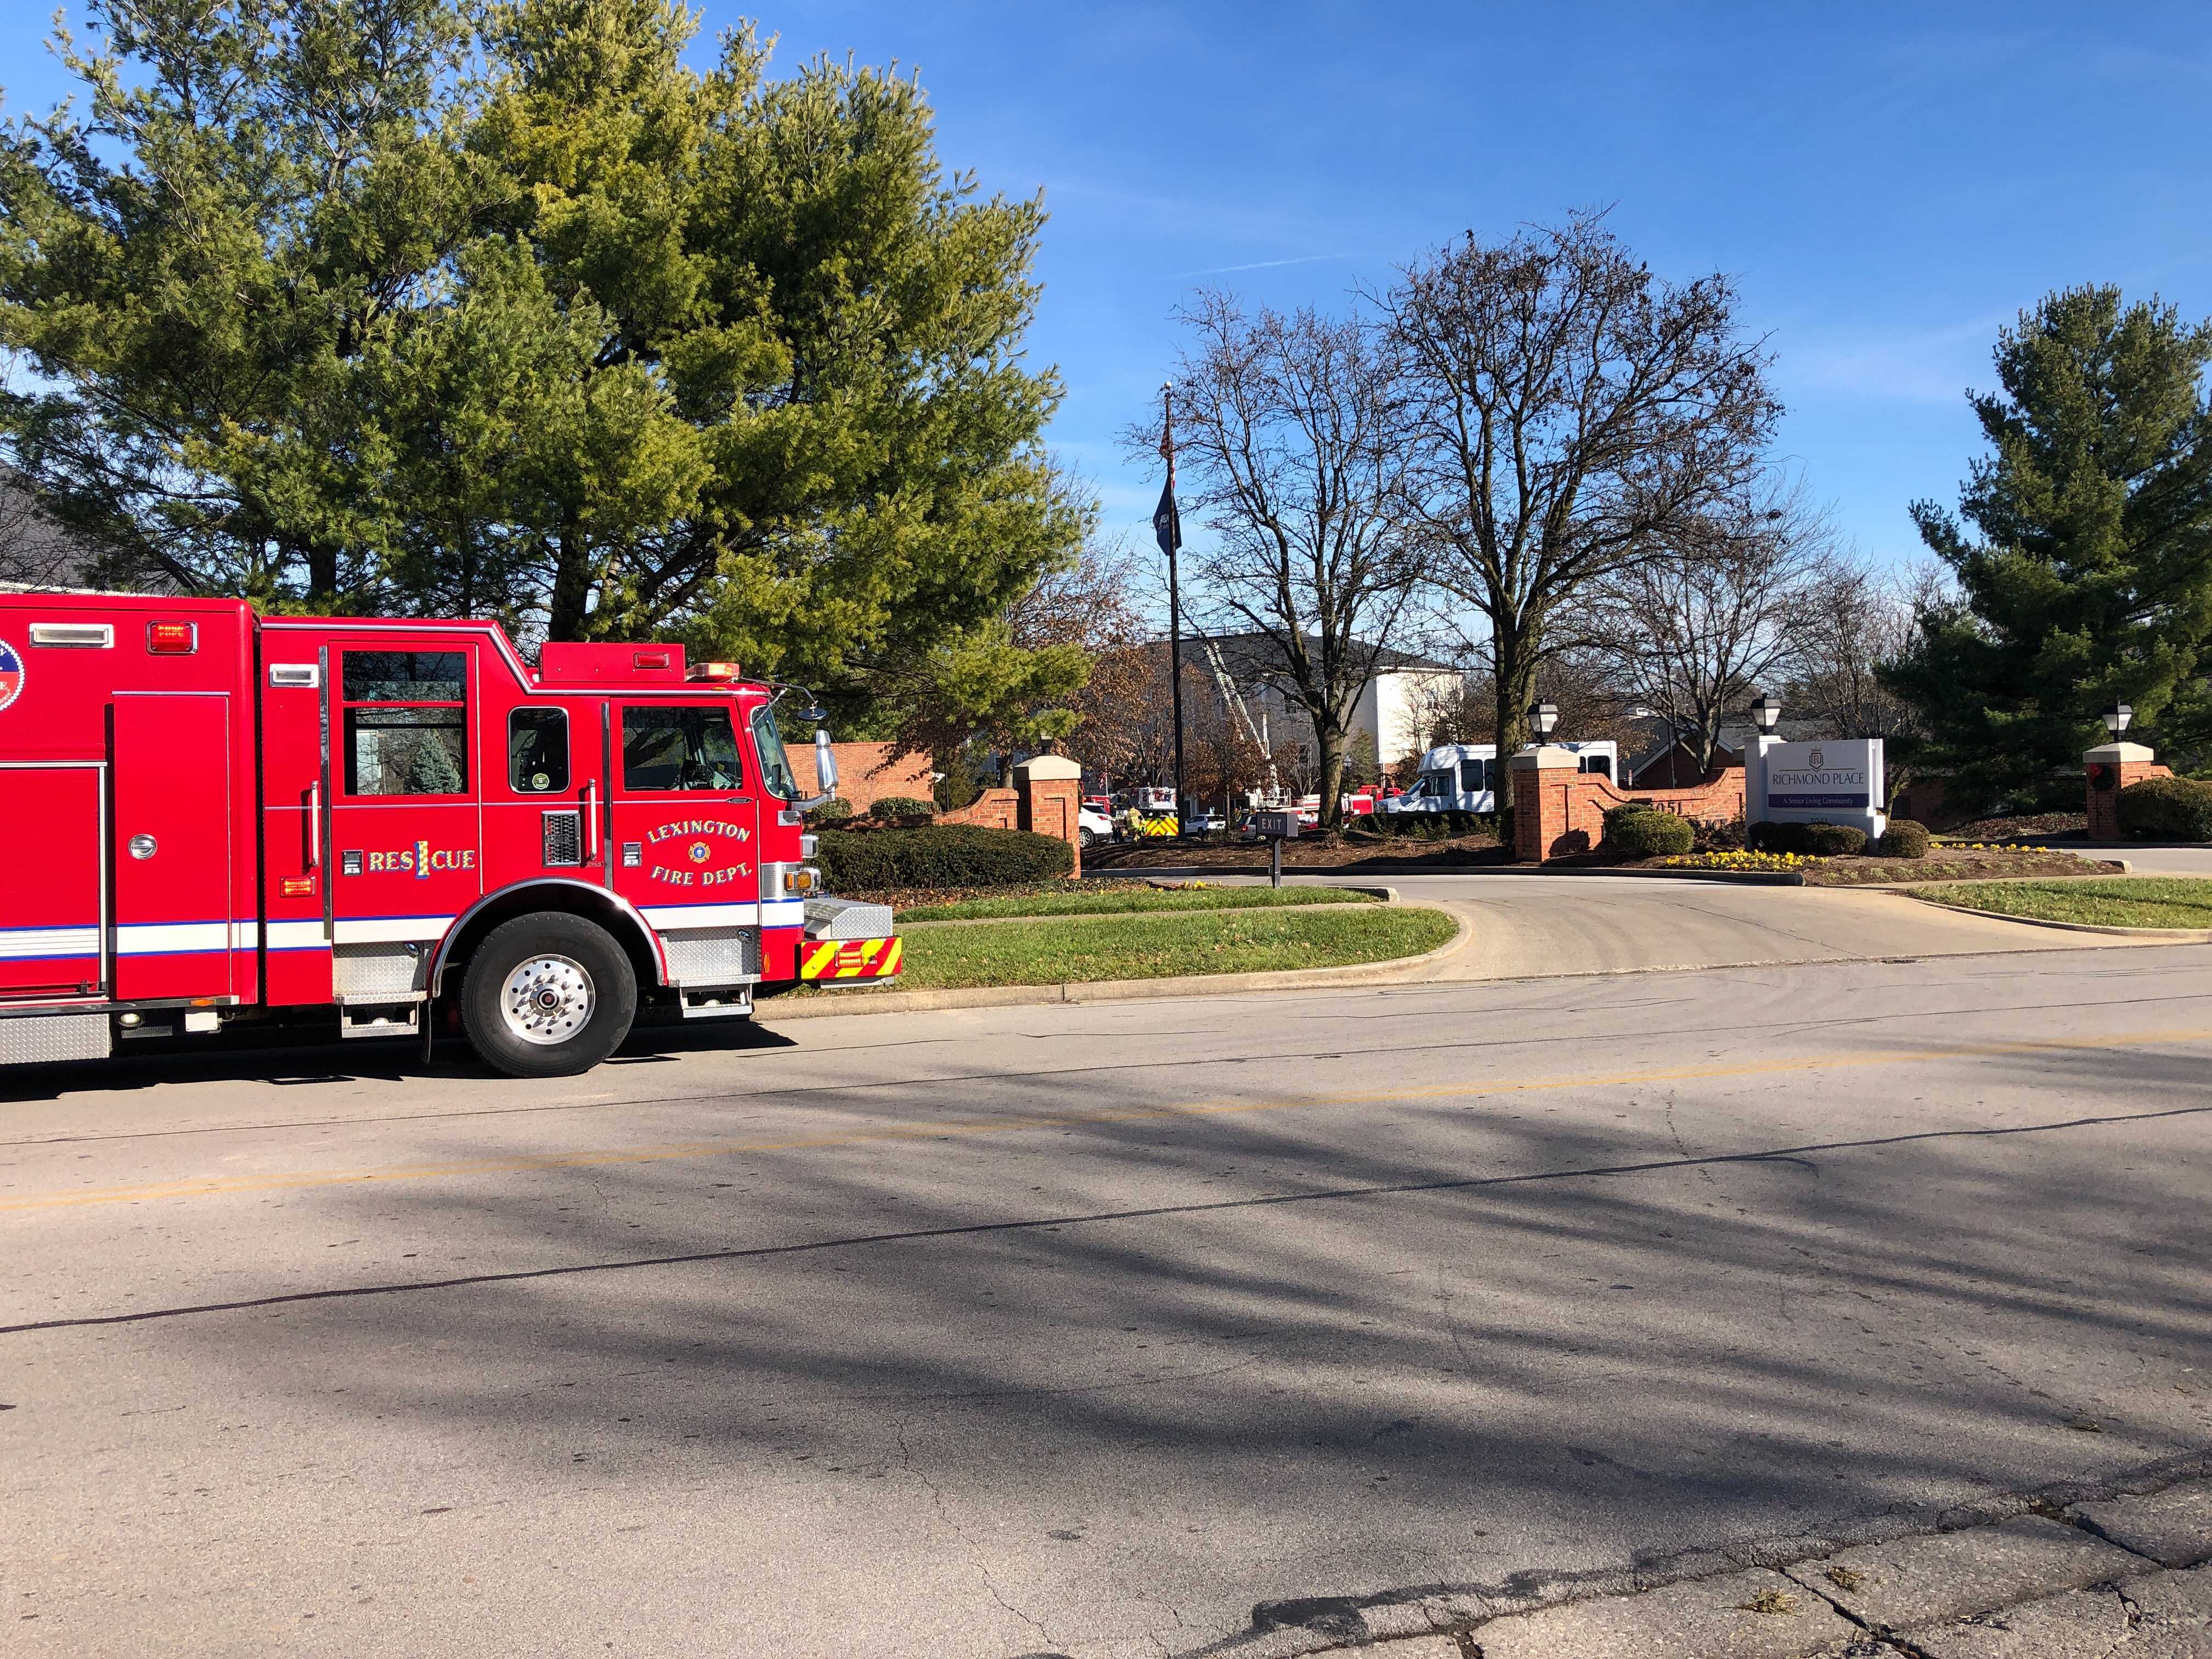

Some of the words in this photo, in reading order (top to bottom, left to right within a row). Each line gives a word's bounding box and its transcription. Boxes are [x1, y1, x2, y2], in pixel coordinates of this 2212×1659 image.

[1773, 773, 1830, 786] RICHMOND
[1833, 772, 1865, 785] PLACE
[1805, 797, 1821, 806] Living
[1822, 797, 1853, 806] Community
[1262, 818, 1282, 830] EXIT
[646, 820, 751, 845] LEXINGTON
[650, 865, 695, 886] FIRE
[702, 862, 752, 886] DEPT.
